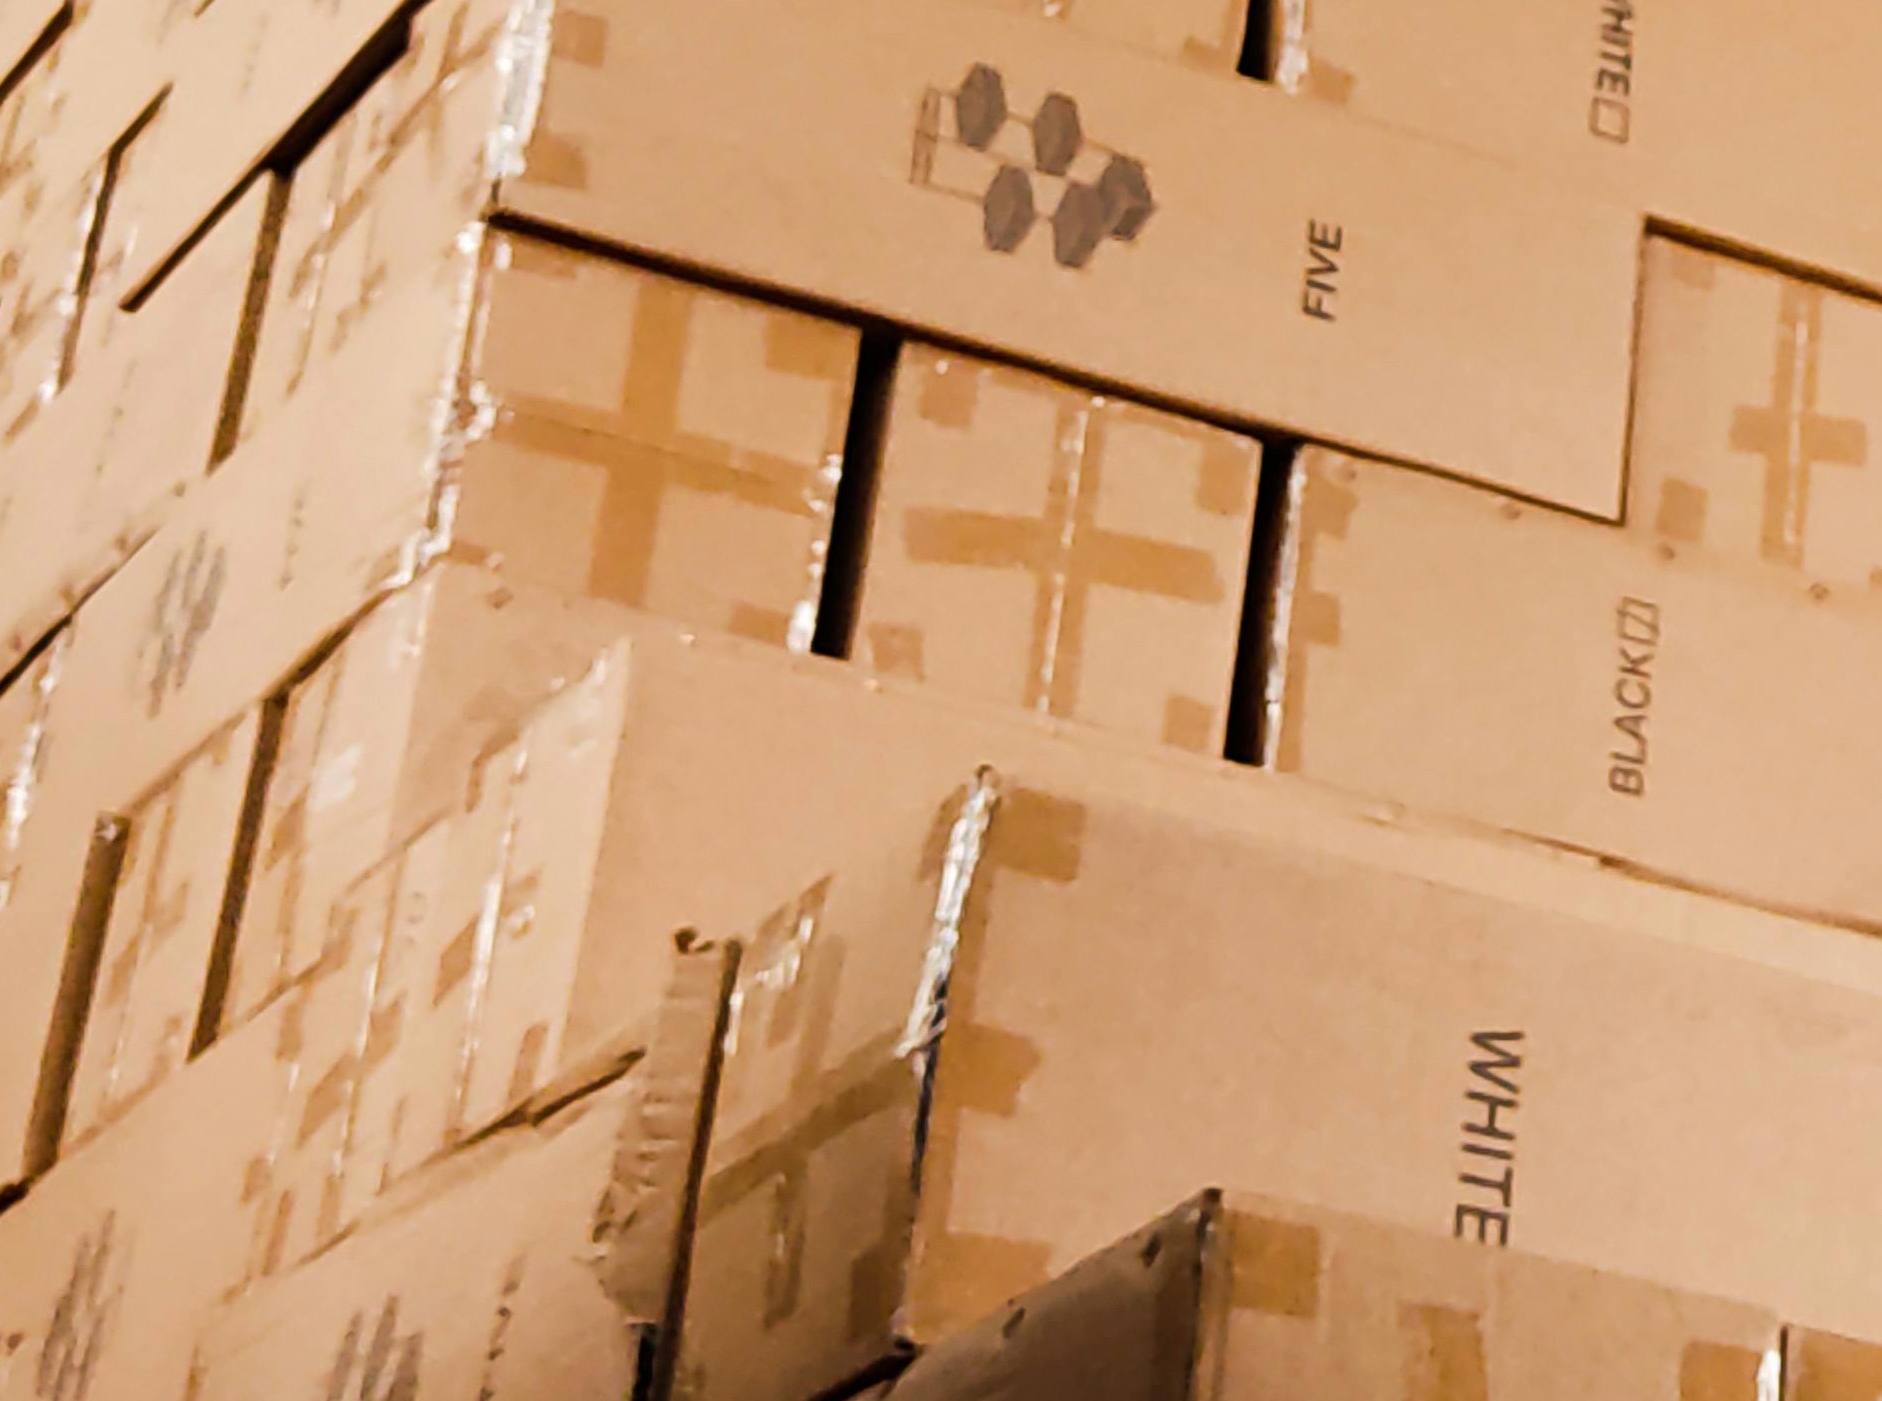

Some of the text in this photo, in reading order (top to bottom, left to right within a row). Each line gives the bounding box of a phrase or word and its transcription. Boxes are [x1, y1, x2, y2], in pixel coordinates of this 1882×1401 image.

[1302, 220, 1342, 321] FIVE
[1608, 647, 1654, 797] BLACK
[1454, 1031, 1524, 1248] WHITE
